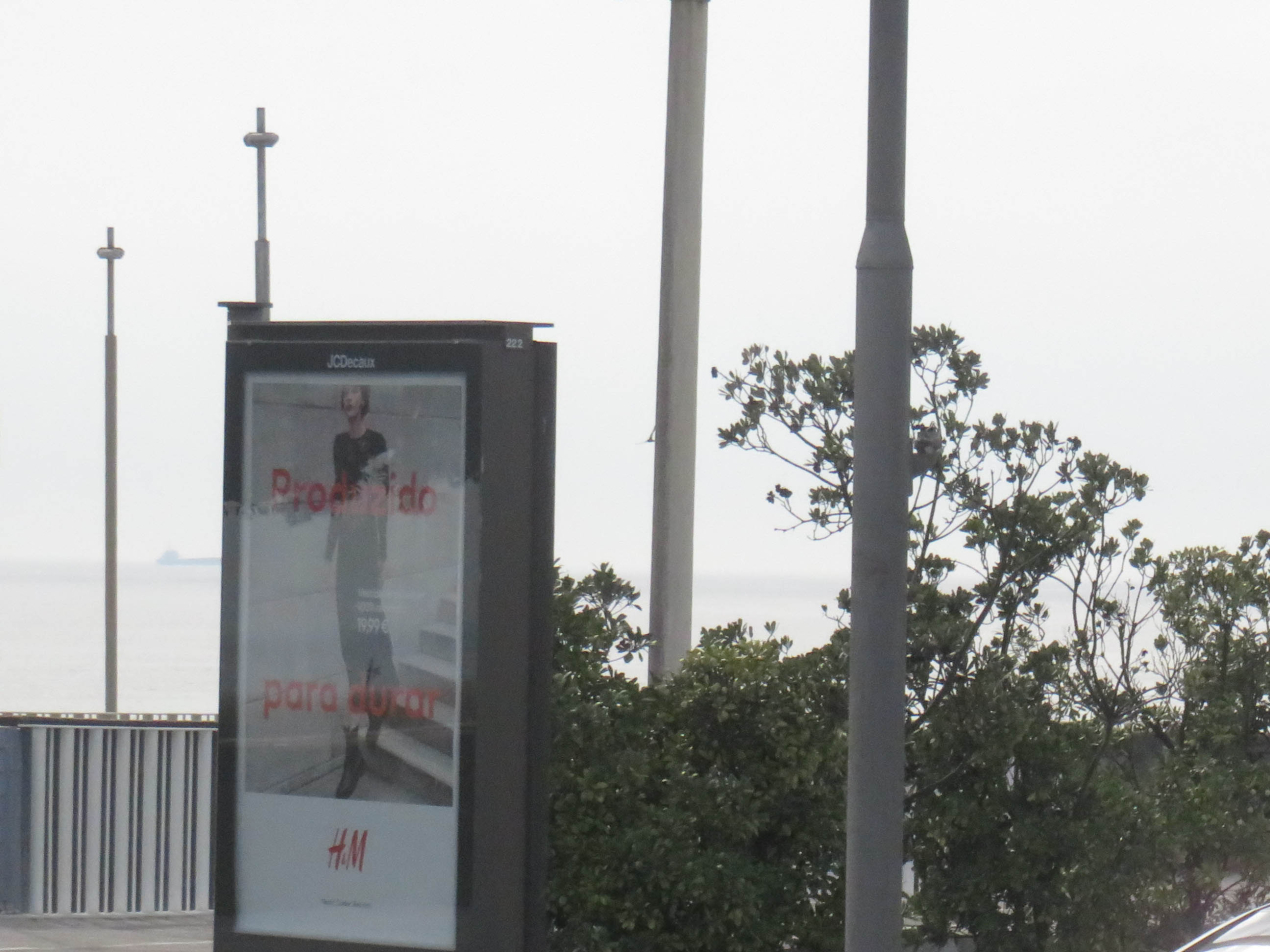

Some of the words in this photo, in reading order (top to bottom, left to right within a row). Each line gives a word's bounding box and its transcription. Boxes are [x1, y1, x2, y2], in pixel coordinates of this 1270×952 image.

[506, 338, 523, 349] 222
[327, 354, 376, 369] JCDecaux
[263, 679, 338, 719] para
[347, 671, 441, 720] durar
[327, 827, 368, 873] H&M
